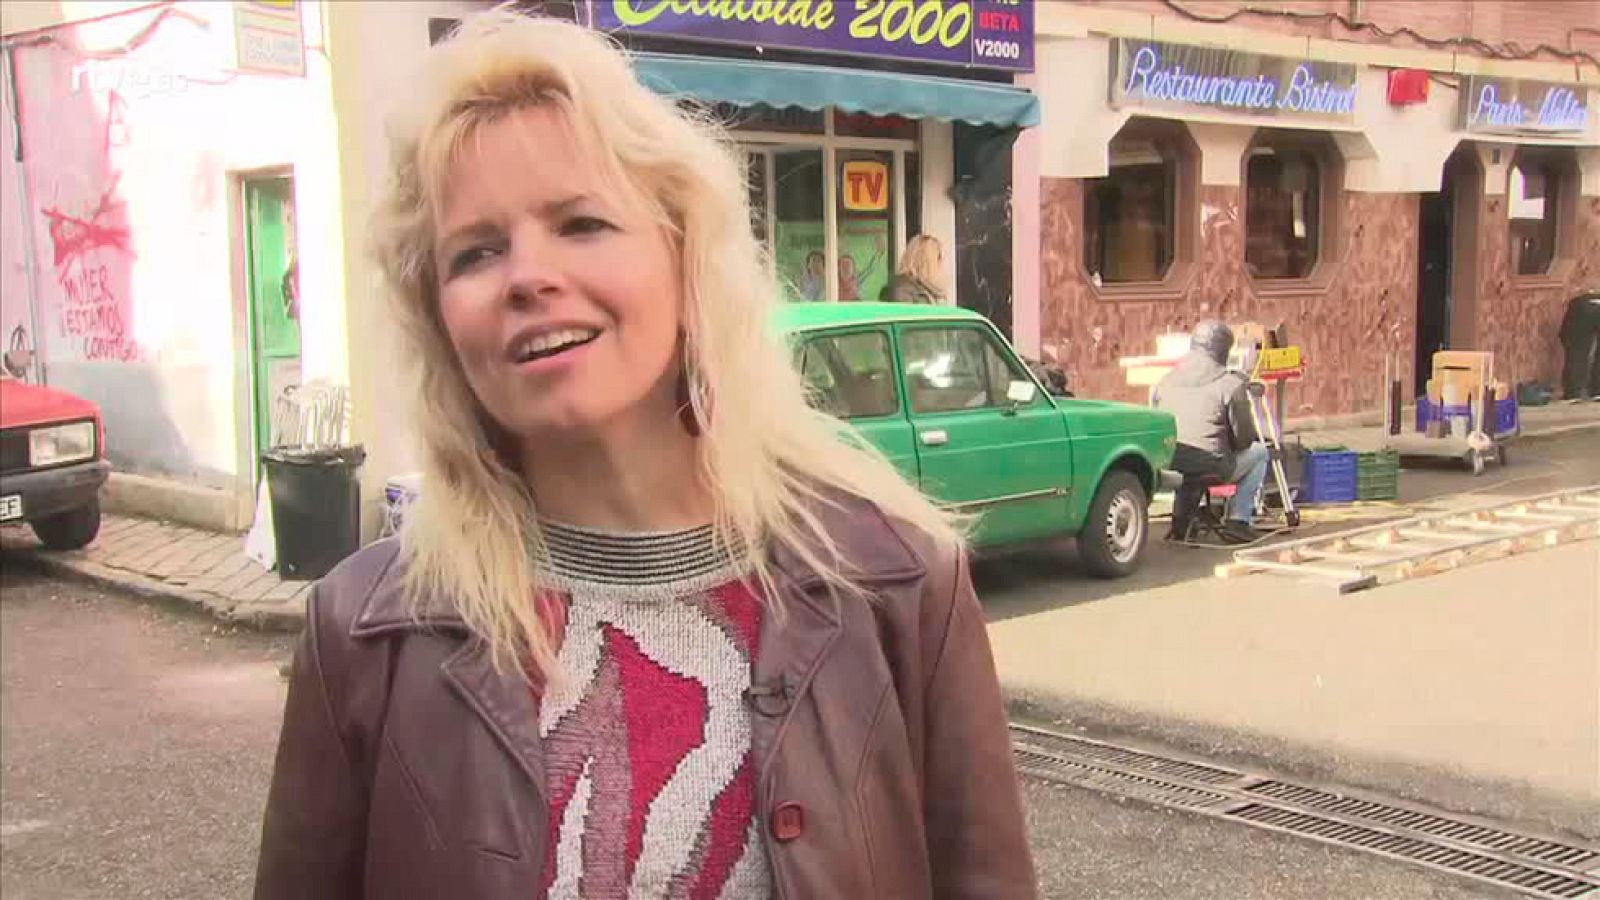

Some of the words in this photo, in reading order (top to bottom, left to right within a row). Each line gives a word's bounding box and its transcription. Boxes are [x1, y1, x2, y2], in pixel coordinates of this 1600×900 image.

[849, 0, 971, 48] 2000
[979, 11, 1020, 33] BETA
[975, 38, 1020, 59] V2000
[1124, 47, 1275, 107] Restaurante
[846, 171, 884, 204] TV
